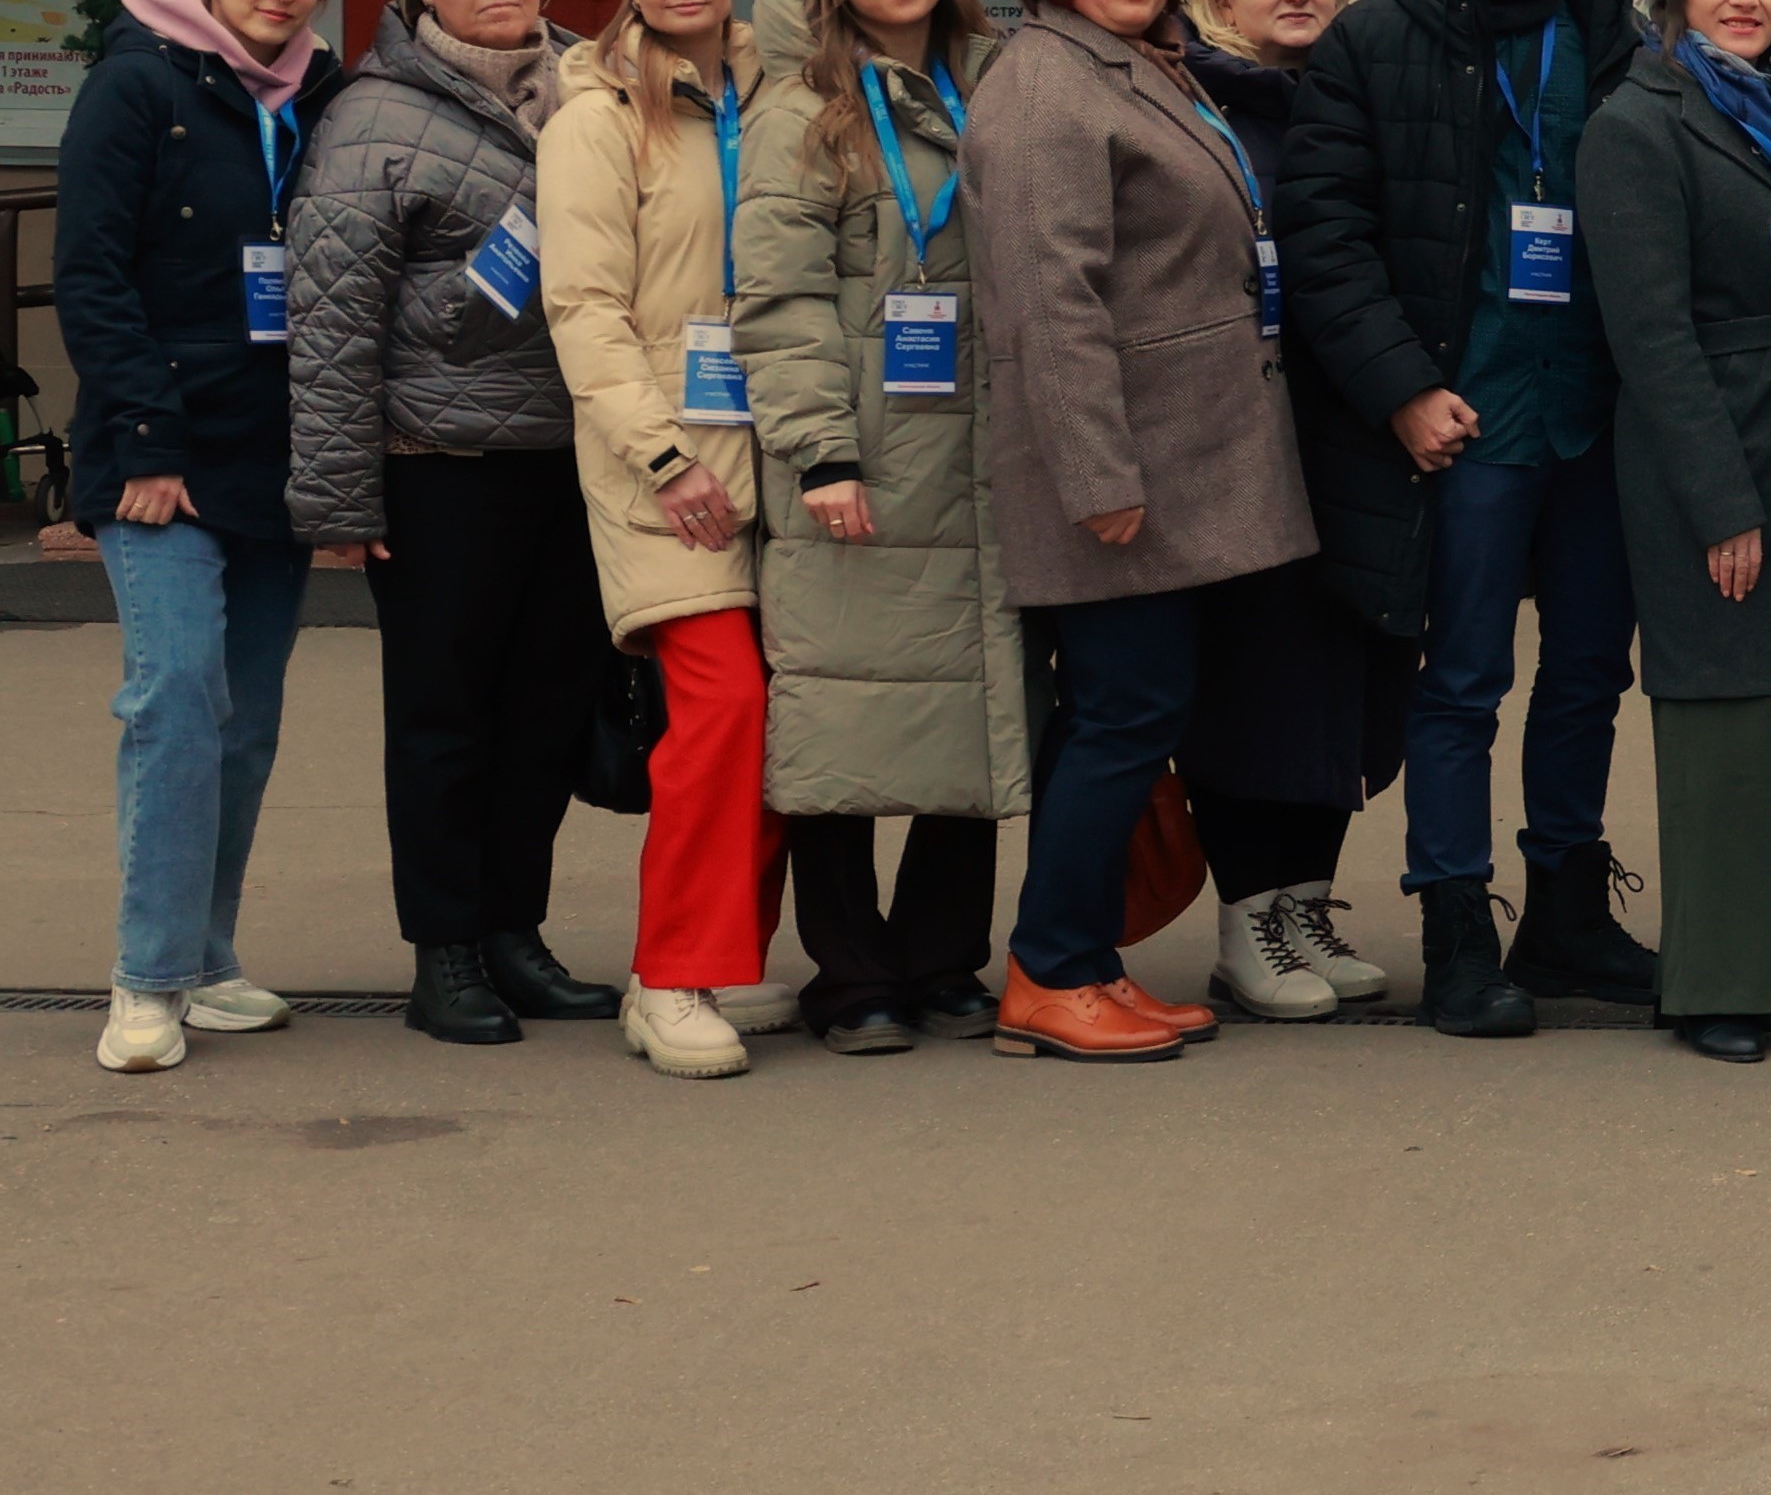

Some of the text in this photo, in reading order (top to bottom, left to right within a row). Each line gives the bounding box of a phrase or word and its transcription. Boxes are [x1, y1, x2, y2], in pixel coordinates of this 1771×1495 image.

[10, 68, 48, 78] этаже
[8, 84, 71, 95] «Радость»
[1527, 244, 1559, 253] Дмитрий
[1522, 251, 1562, 261] Борисович
